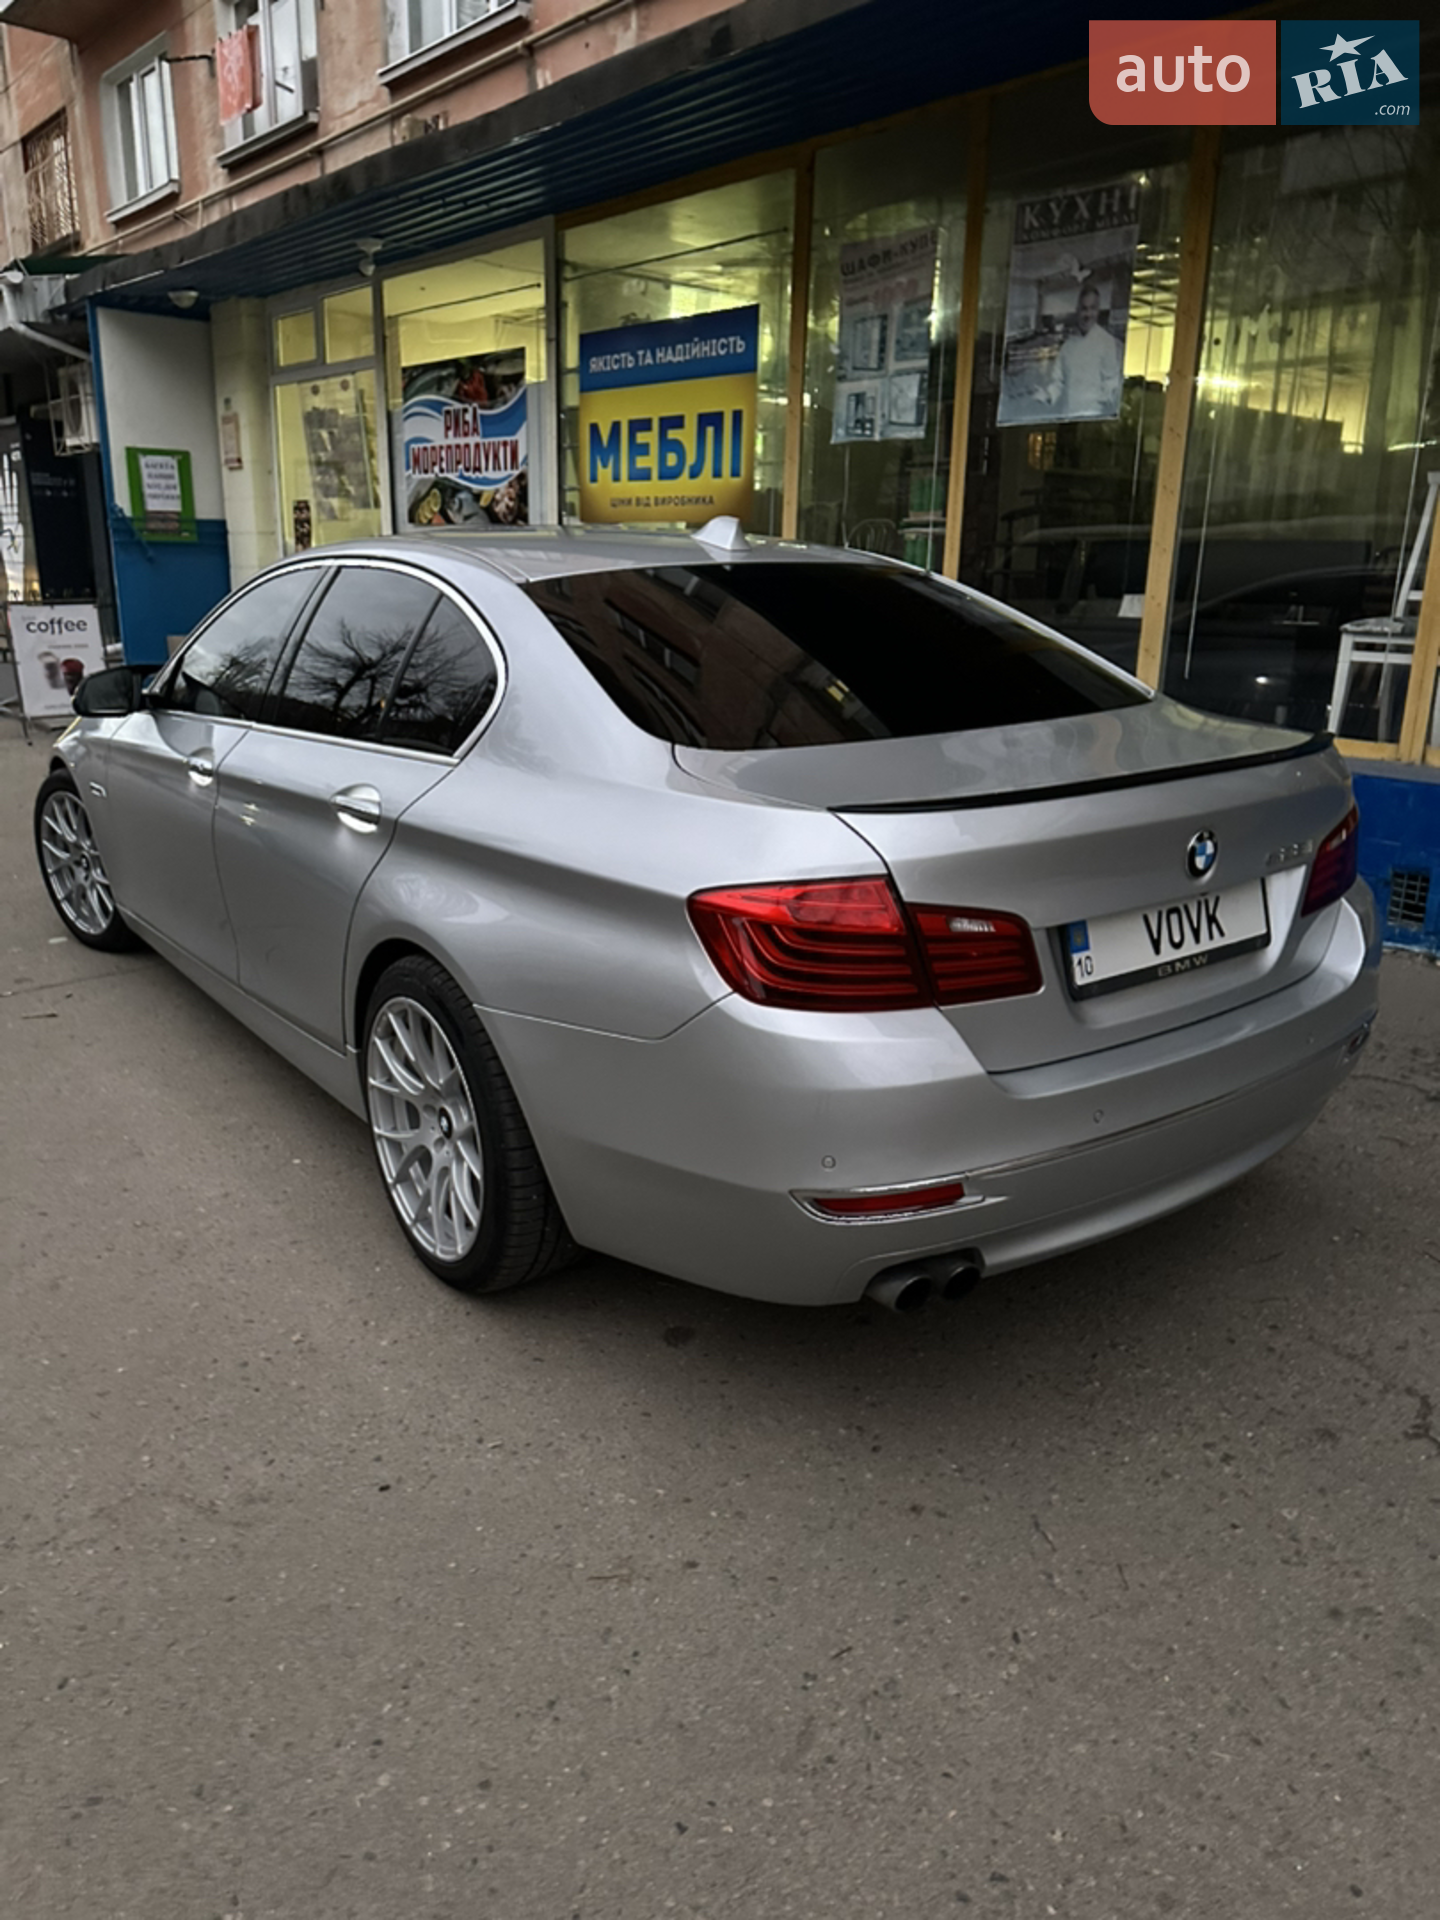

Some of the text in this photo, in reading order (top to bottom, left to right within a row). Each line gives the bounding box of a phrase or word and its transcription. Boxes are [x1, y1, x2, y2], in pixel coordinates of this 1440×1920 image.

[1023, 185, 1138, 230] КУХНІ
[589, 335, 746, 373] ЯКІСТЬ ТА НАДІЙНІСТЬ
[444, 406, 480, 438] РИБА
[412, 440, 519, 475] МОРЕПРОДУКТИ
[589, 409, 743, 484] МЕБЛІ
[635, 496, 651, 508] ВІД
[654, 495, 715, 507] ВИРОБНИКА
[26, 617, 88, 635] coffee
[1143, 895, 1225, 956] VOVK
[1076, 956, 1095, 979] 10
[1157, 953, 1209, 977] BMW
